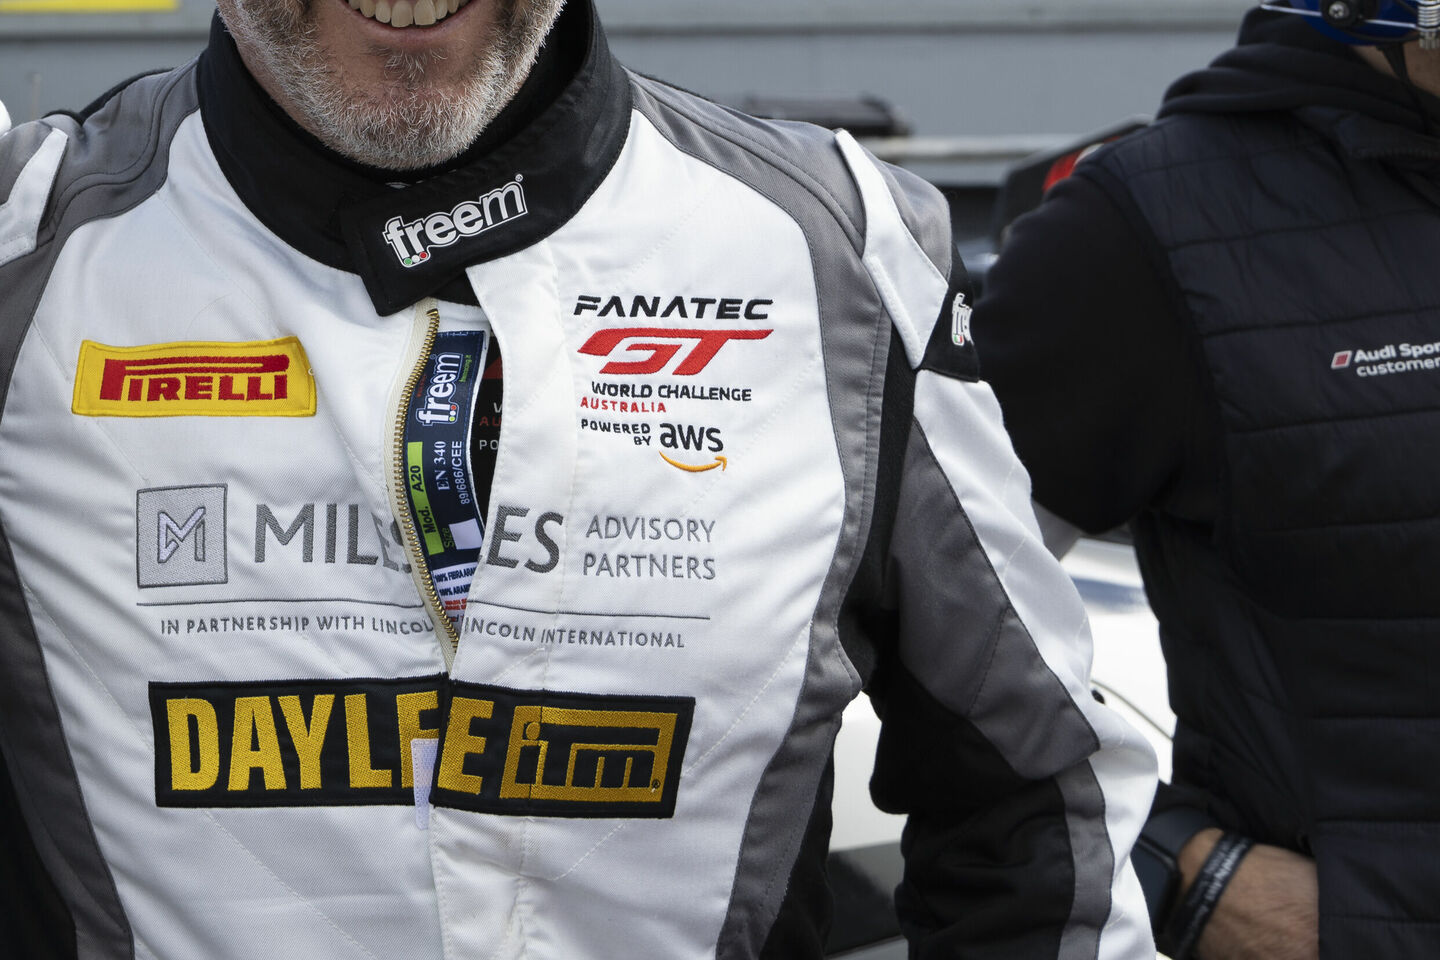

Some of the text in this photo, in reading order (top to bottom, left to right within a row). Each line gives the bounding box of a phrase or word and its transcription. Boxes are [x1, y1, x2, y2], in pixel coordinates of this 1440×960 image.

[384, 182, 527, 264] freem
[573, 294, 774, 320] FANATEC
[577, 327, 774, 376] GT
[1354, 342, 1440, 363] Audi Spor
[100, 354, 290, 401] PIRELLI
[417, 352, 462, 425] freem
[591, 381, 752, 401] WORLD CHALLENGE
[580, 397, 667, 413] AUSTRALIA
[581, 419, 651, 434] POWERED
[634, 436, 652, 446] BY
[659, 422, 724, 452] aws
[434, 441, 450, 491] EN 340
[450, 440, 471, 506] 89/686/CEE
[410, 465, 437, 534] Mod. A20
[585, 514, 716, 543] ADVISORY
[583, 552, 716, 580] PARTNERS
[161, 619, 180, 634] IN
[187, 616, 310, 633] PARTNERSHIP
[316, 616, 365, 631] WITH
[541, 629, 685, 648] INTERNATIONAL
